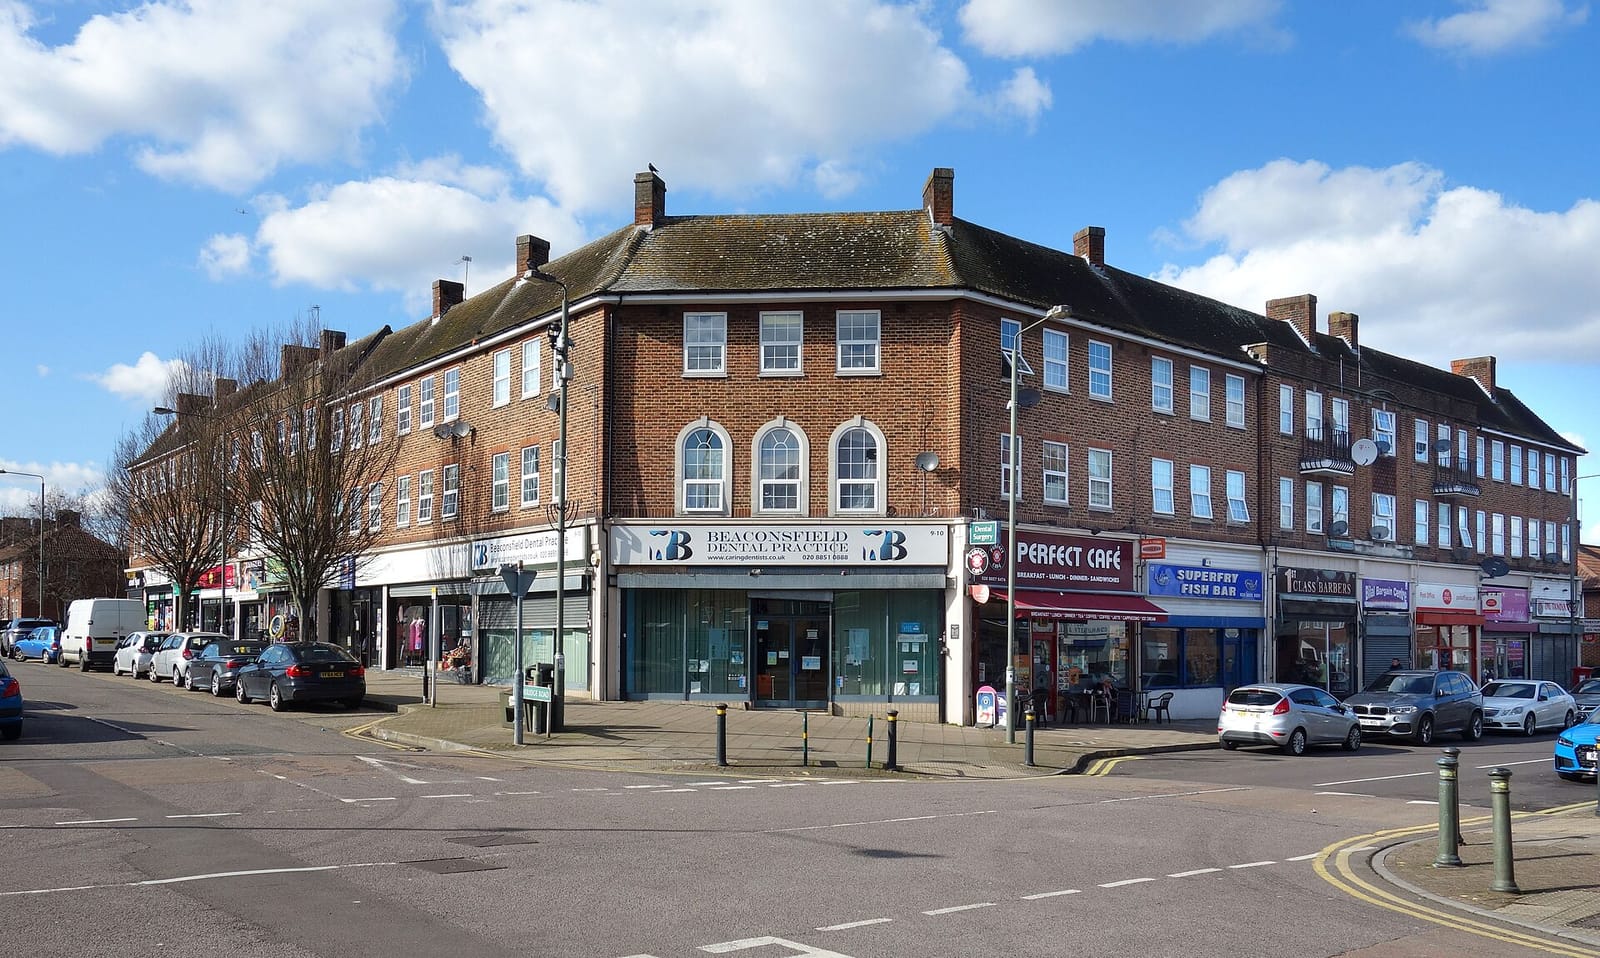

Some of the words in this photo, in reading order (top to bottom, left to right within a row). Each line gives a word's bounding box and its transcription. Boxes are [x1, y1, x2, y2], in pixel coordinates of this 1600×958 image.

[707, 531, 848, 542] BEACONSFIELD
[973, 533, 993, 541] Surgery
[490, 541, 524, 553] Beaconsfield
[525, 538, 544, 550] Dental
[707, 543, 768, 553] DENTAL
[772, 543, 848, 553] PRACTICE
[707, 554, 785, 562] www.caringdentists.co.uk
[1017, 542, 1082, 567] PERFECT
[1086, 546, 1121, 570] CAFÉ
[1016, 572, 1045, 580] BREAKFAST
[1177, 569, 1239, 583] SUPERFRY
[1181, 583, 1209, 595] FISH
[1212, 586, 1237, 596] BAR
[1293, 580, 1316, 593] CLASS
[1318, 581, 1352, 594] BARBERS
[1376, 585, 1393, 597] Bargain
